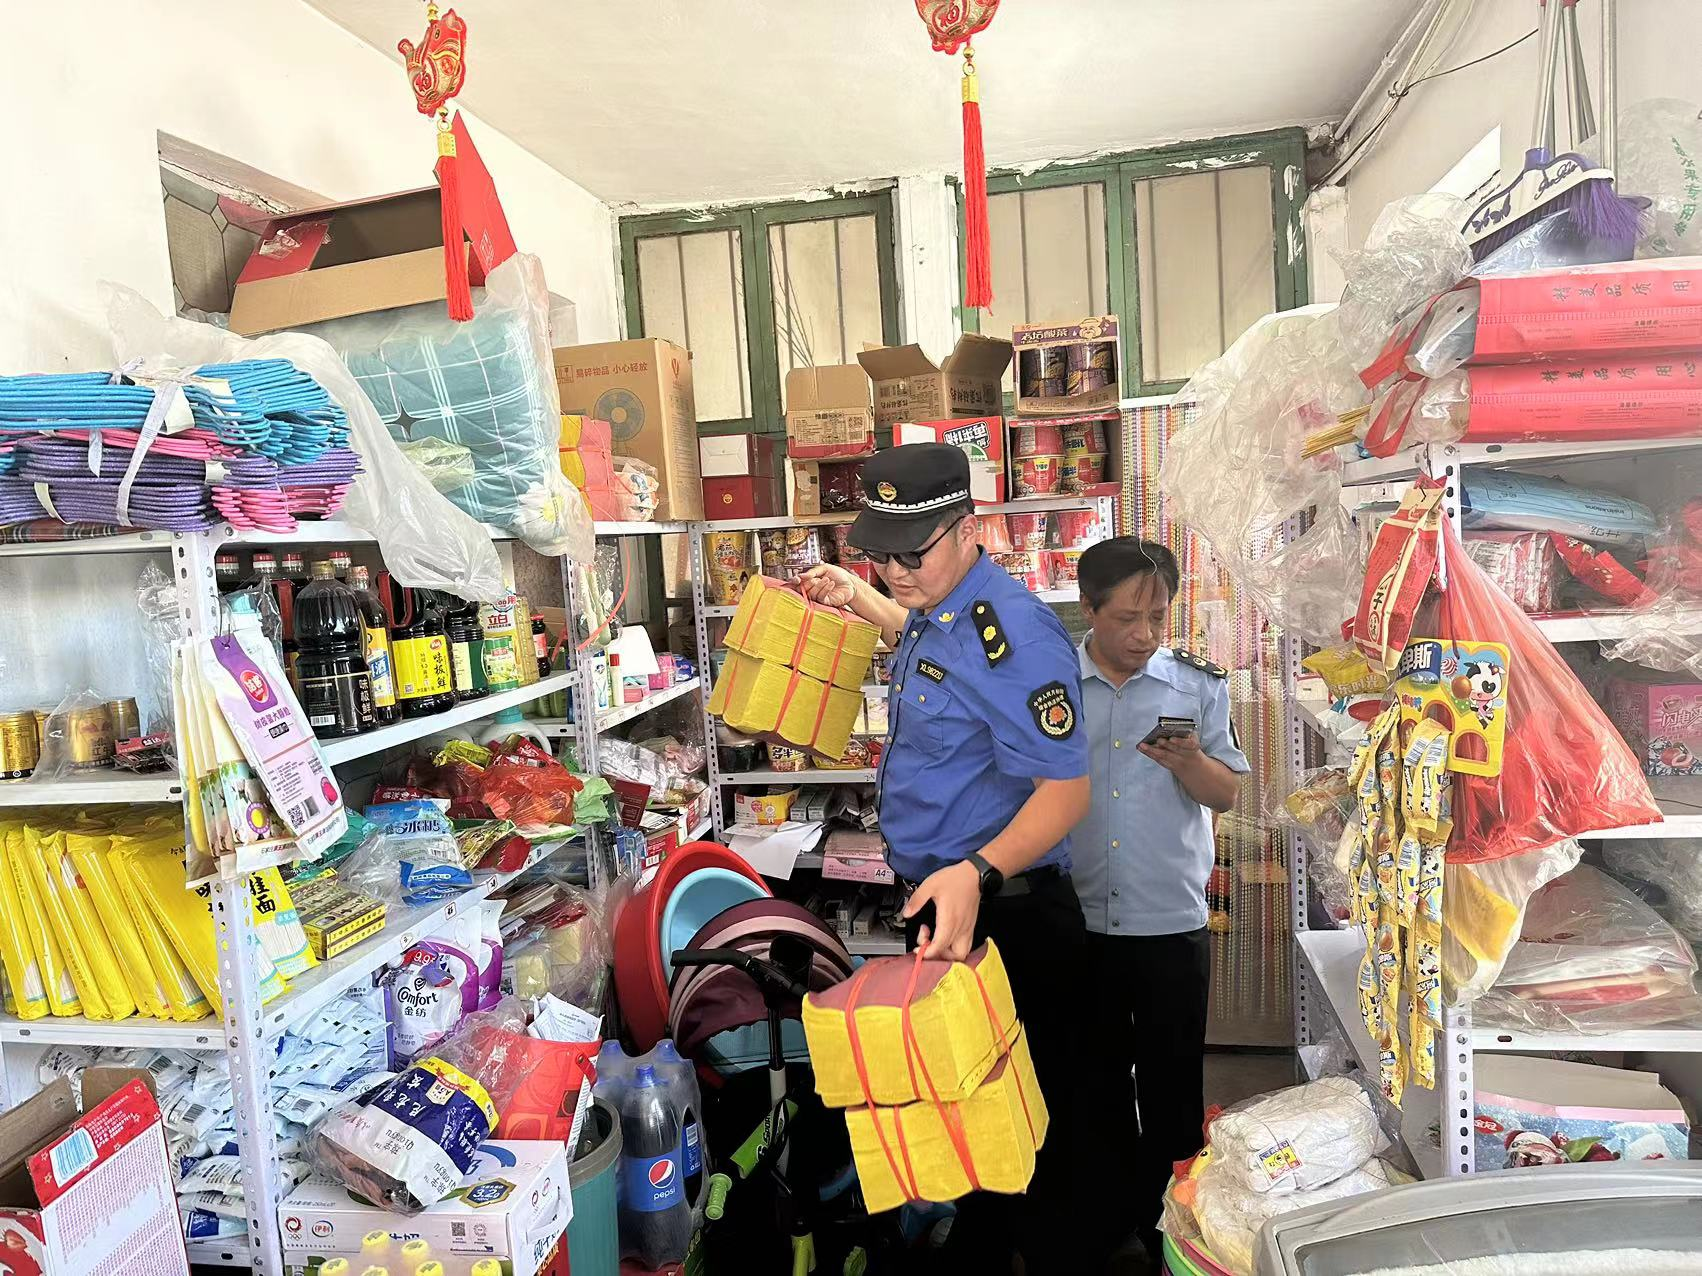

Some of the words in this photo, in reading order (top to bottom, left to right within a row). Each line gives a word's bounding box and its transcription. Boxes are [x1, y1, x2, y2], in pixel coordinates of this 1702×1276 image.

[613, 361, 648, 374] 小心轻放
[487, 613, 509, 625] 立白
[875, 869, 886, 877] A4
[397, 986, 439, 1008] Comfort
[404, 1006, 427, 1018] 金纺
[385, 1129, 415, 1151] Qiongyu
[653, 1186, 676, 1201] pepsi
